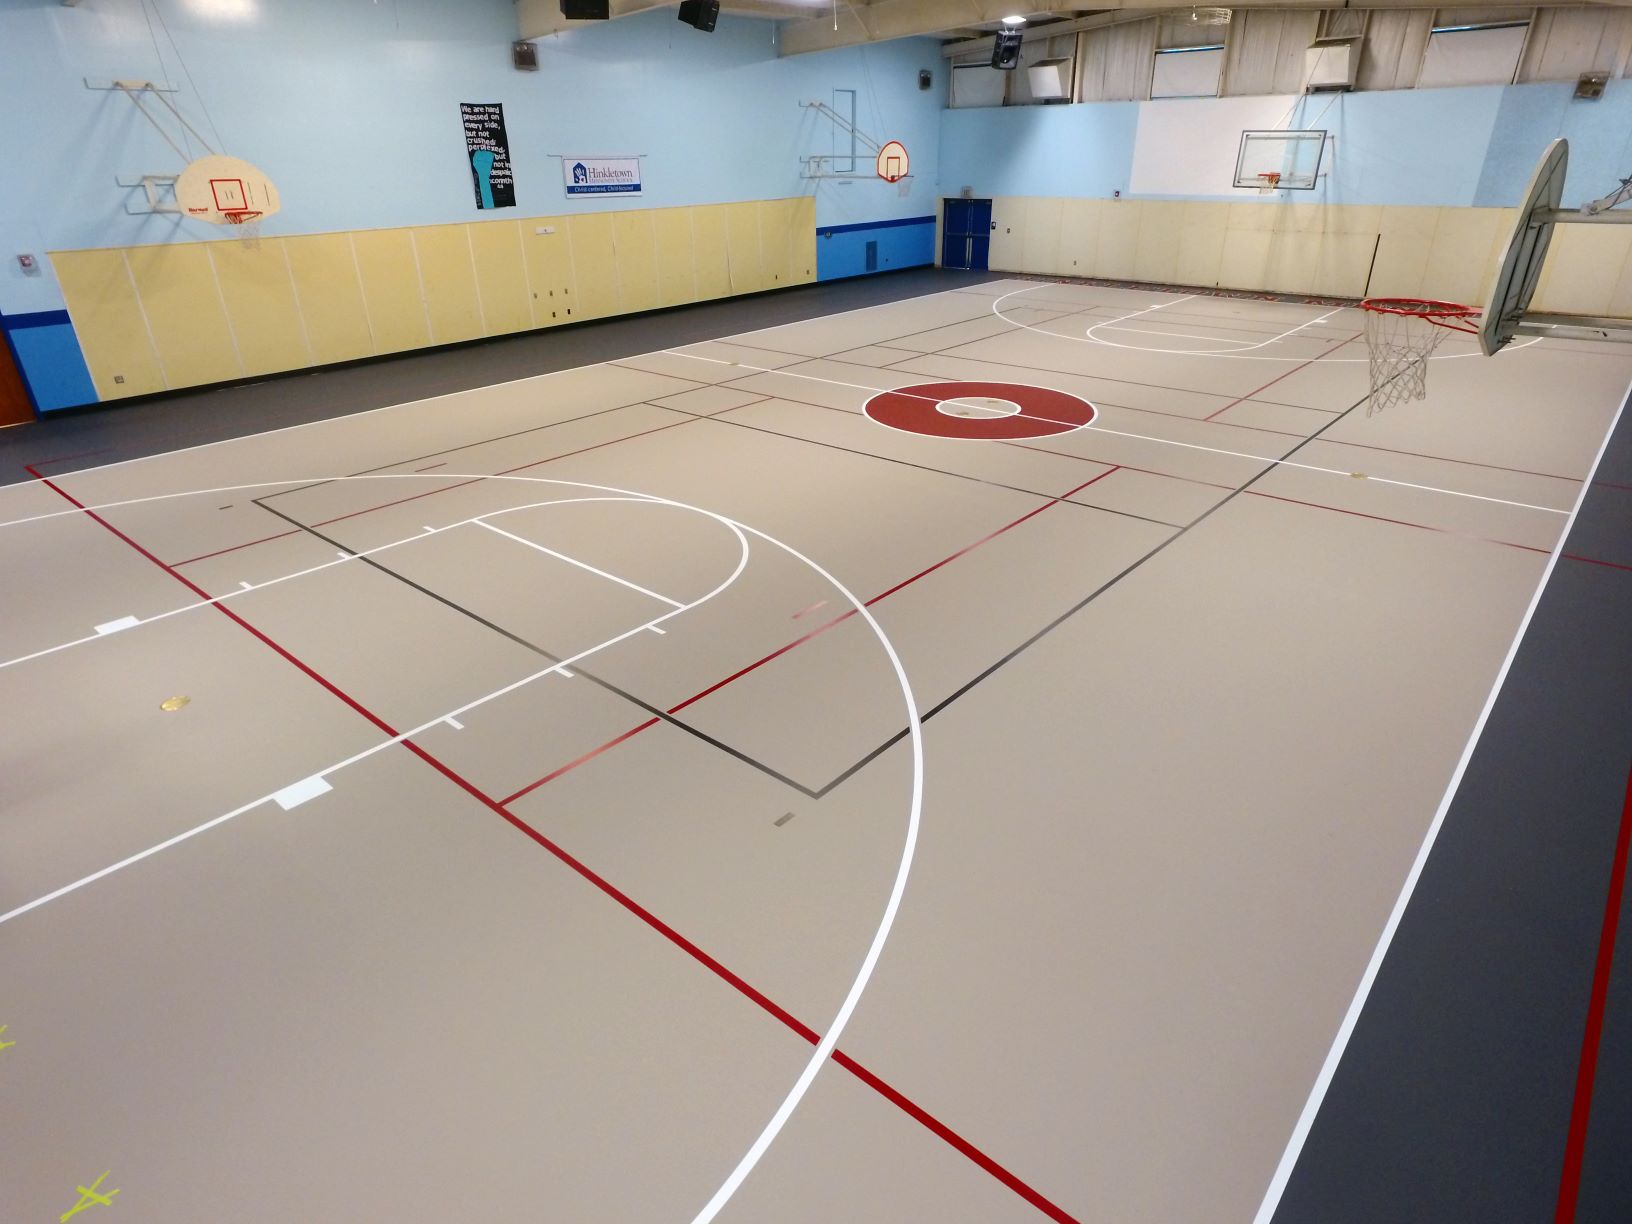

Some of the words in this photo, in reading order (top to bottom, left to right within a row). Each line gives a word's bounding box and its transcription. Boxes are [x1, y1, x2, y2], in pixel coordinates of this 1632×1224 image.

[463, 113, 489, 121] pressed
[465, 122, 482, 130] every
[588, 167, 632, 178] Hinkletown
